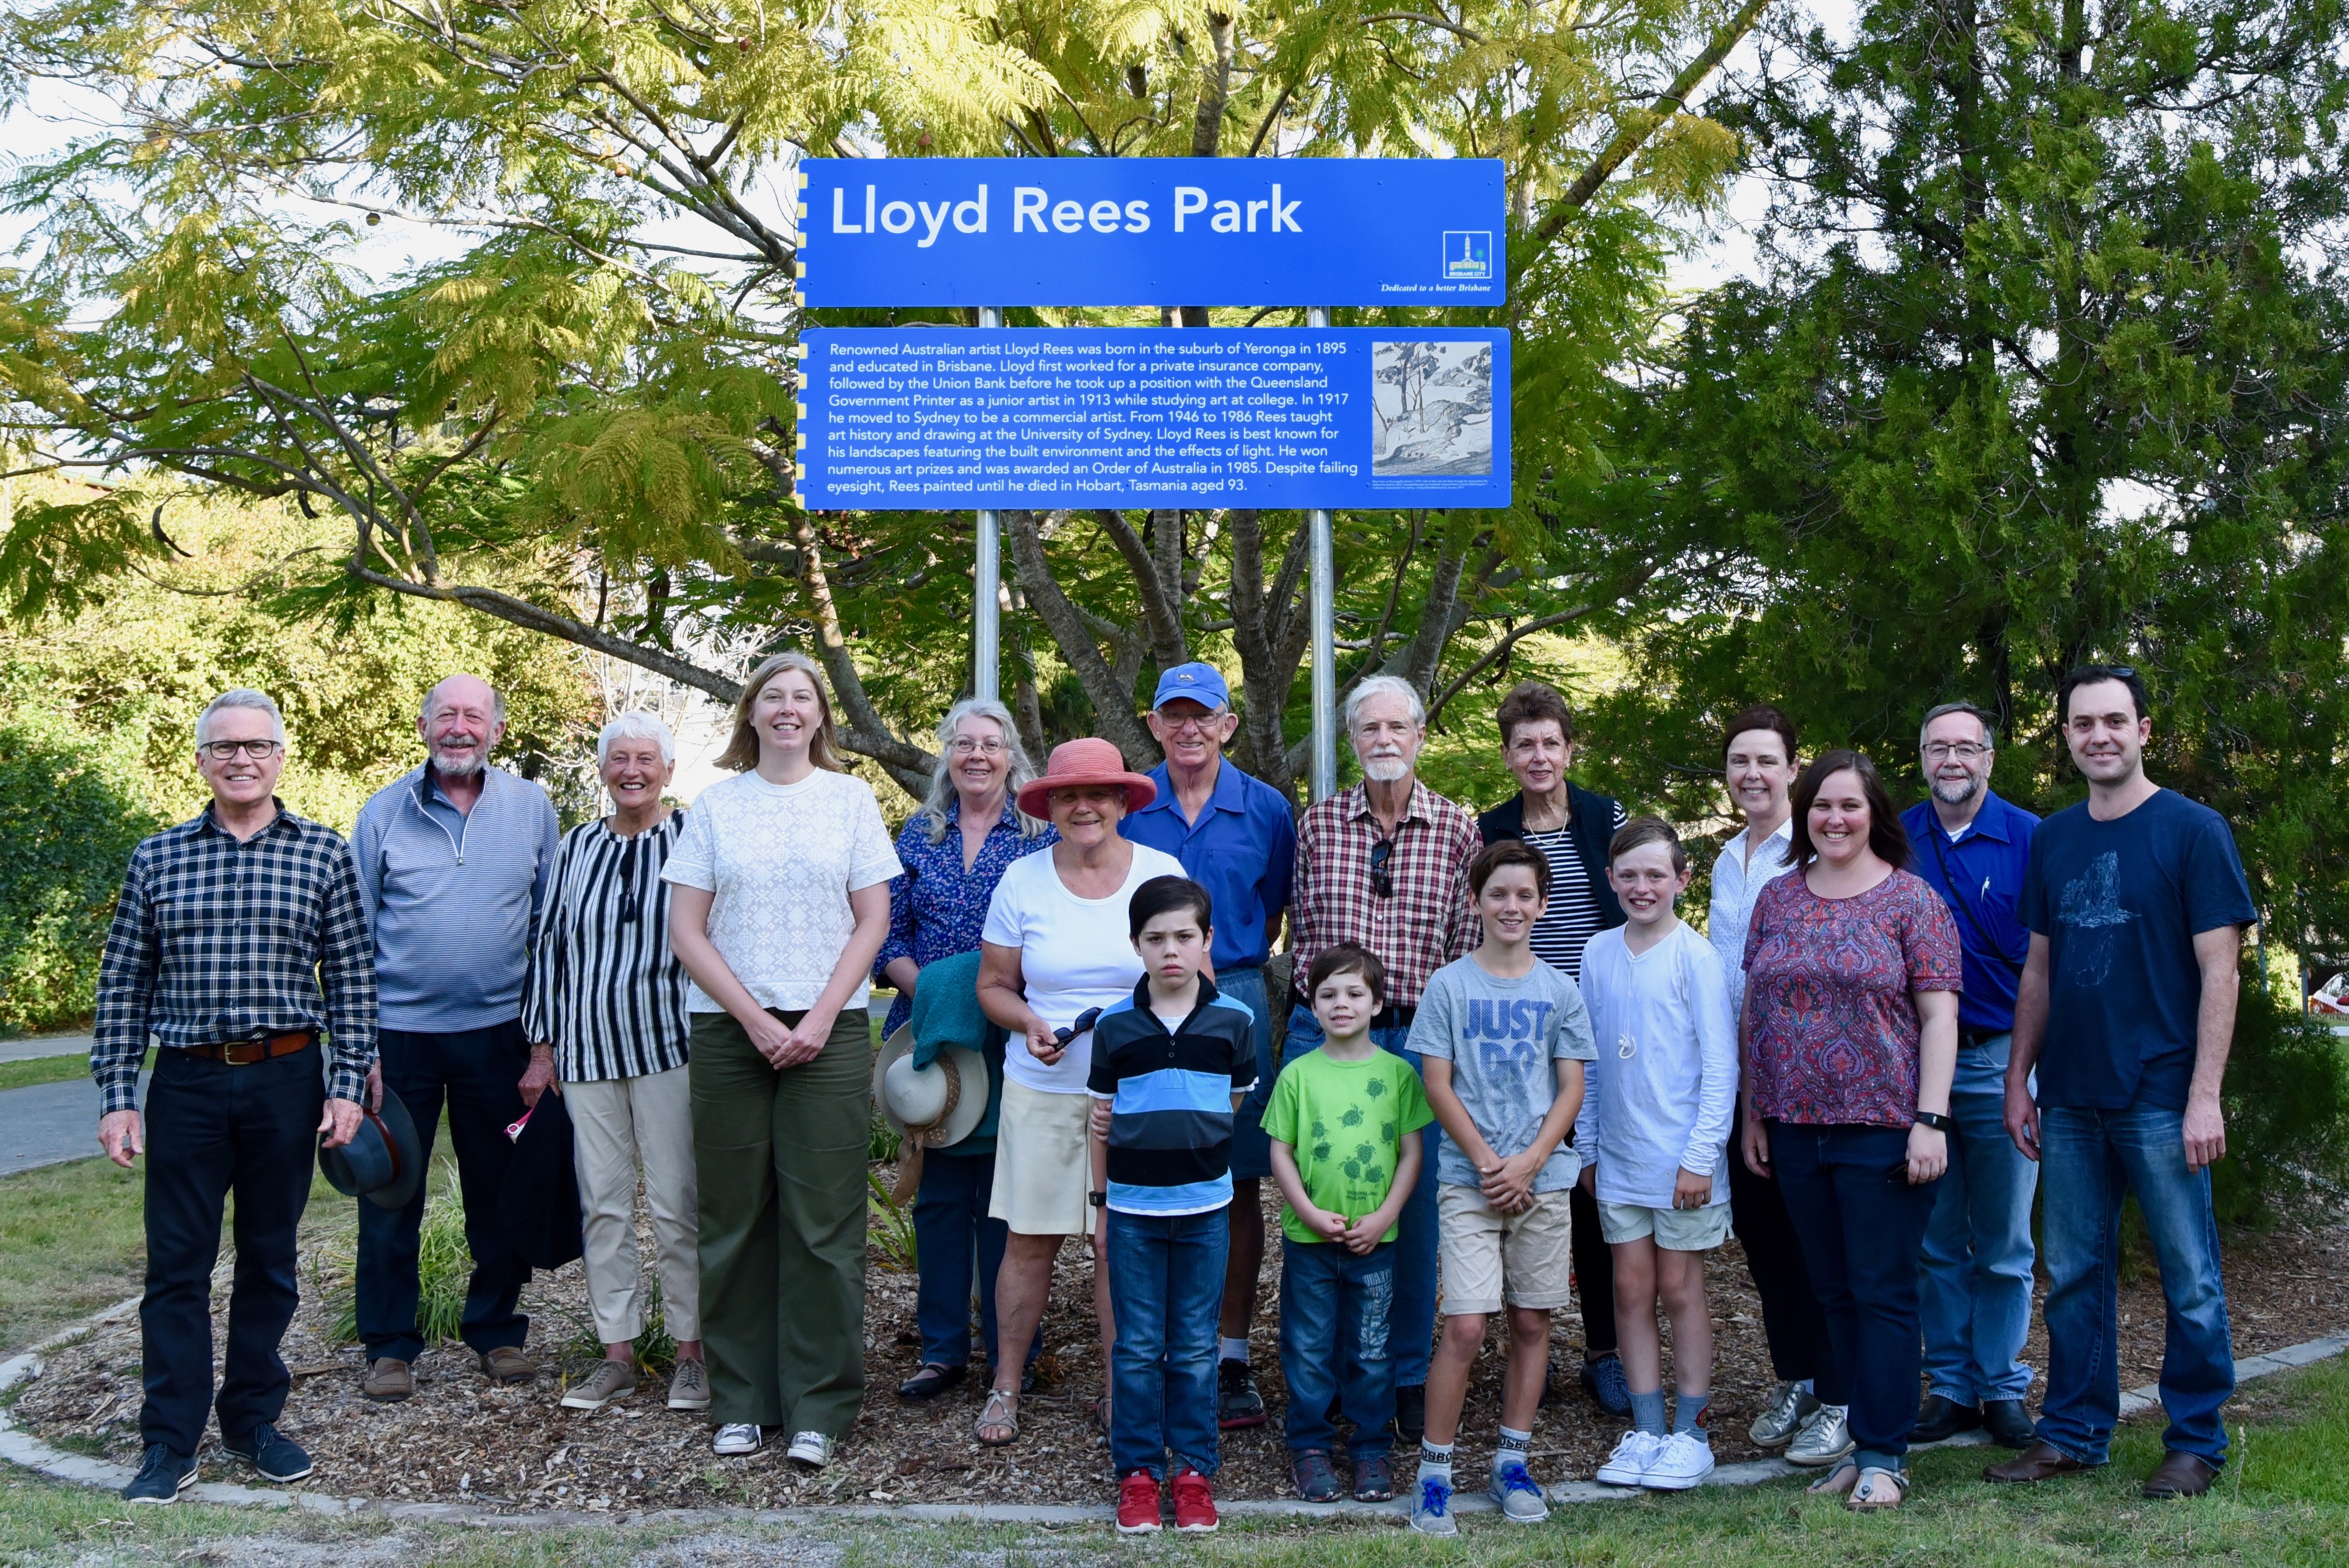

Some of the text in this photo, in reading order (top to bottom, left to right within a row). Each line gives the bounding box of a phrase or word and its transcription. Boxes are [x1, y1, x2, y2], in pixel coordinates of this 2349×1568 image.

[833, 184, 1302, 248] Lloyd Rees Park
[830, 342, 1346, 358] Renowned Australian artist Lloyd Rees was born in the suburb of Yeronga in 1895
[830, 359, 1323, 375] and educated in Brisbane. Lloyd first worked for a private insurance company,
[830, 376, 1328, 392] followed by the Union Bank before he took up a position with the Queensland
[829, 393, 1349, 409] Government Printer as a junior artist in 1913 while studying art at college. In 1917
[829, 410, 1332, 426] he moved to Sydney to be a commercial artist. From 1946 to 1986 Rees taught
[828, 427, 1339, 444] art history and drawing at the University of Sydney. Lloyd Rees is best known for
[828, 444, 1328, 460] his landscapes featuring the built environment and the effects of light. He won
[828, 460, 1358, 477] numerous art prizes and was awarded an Order of Australia in 1985. Despite failing
[827, 479, 1247, 495] eyesight, Rees painted until he died in Hobart, Tasmania aged 93.
[1463, 999, 1553, 1041] JUST
[1479, 1041, 1536, 1084] DO
